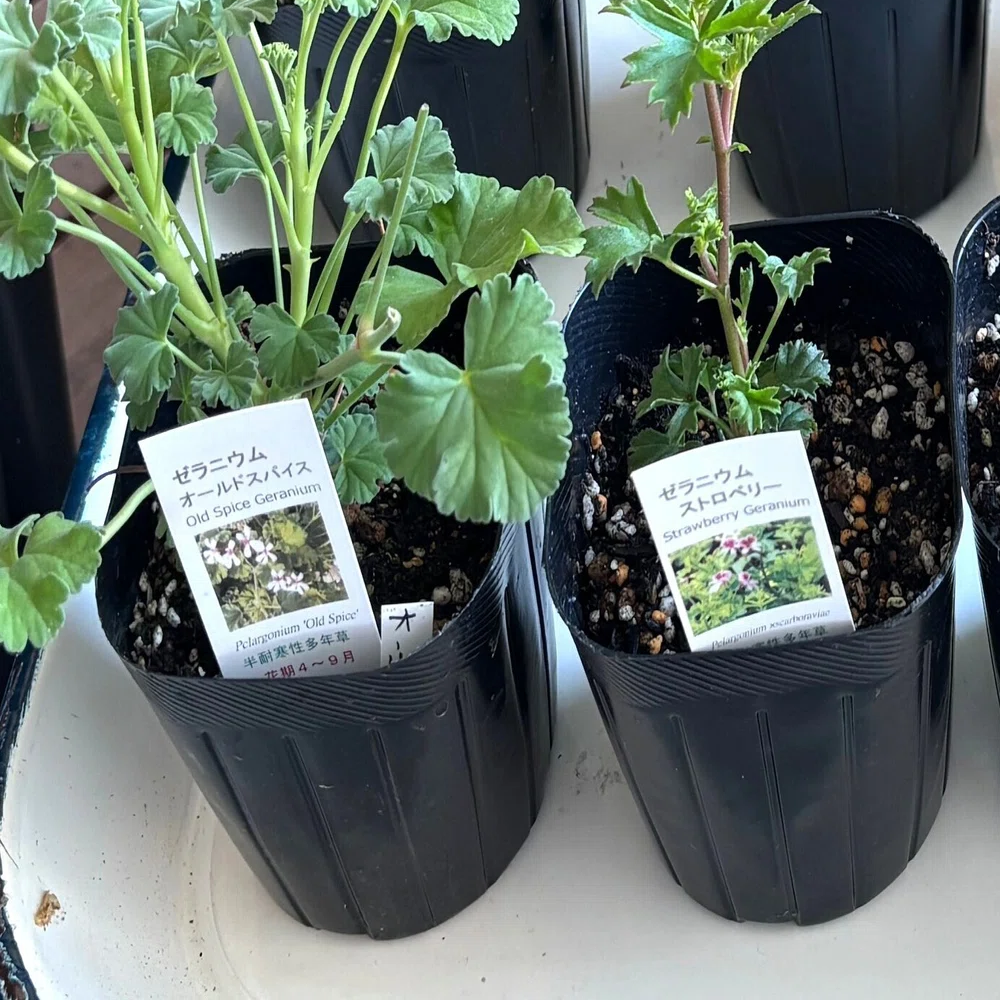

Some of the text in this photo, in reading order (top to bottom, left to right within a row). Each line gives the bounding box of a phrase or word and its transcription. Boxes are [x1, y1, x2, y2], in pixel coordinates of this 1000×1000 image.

[172, 446, 268, 485] ゼラニウム
[179, 460, 312, 508] オールドスパイス
[659, 464, 754, 502] ゼラニウム
[185, 482, 322, 528] Old Spice Geranium
[663, 496, 811, 544] Strawberry Geranium
[679, 481, 782, 518] ストロベリー
[235, 608, 359, 652] Pelargonium 'Old Spice'
[243, 630, 351, 669] 半耐寒性多年草
